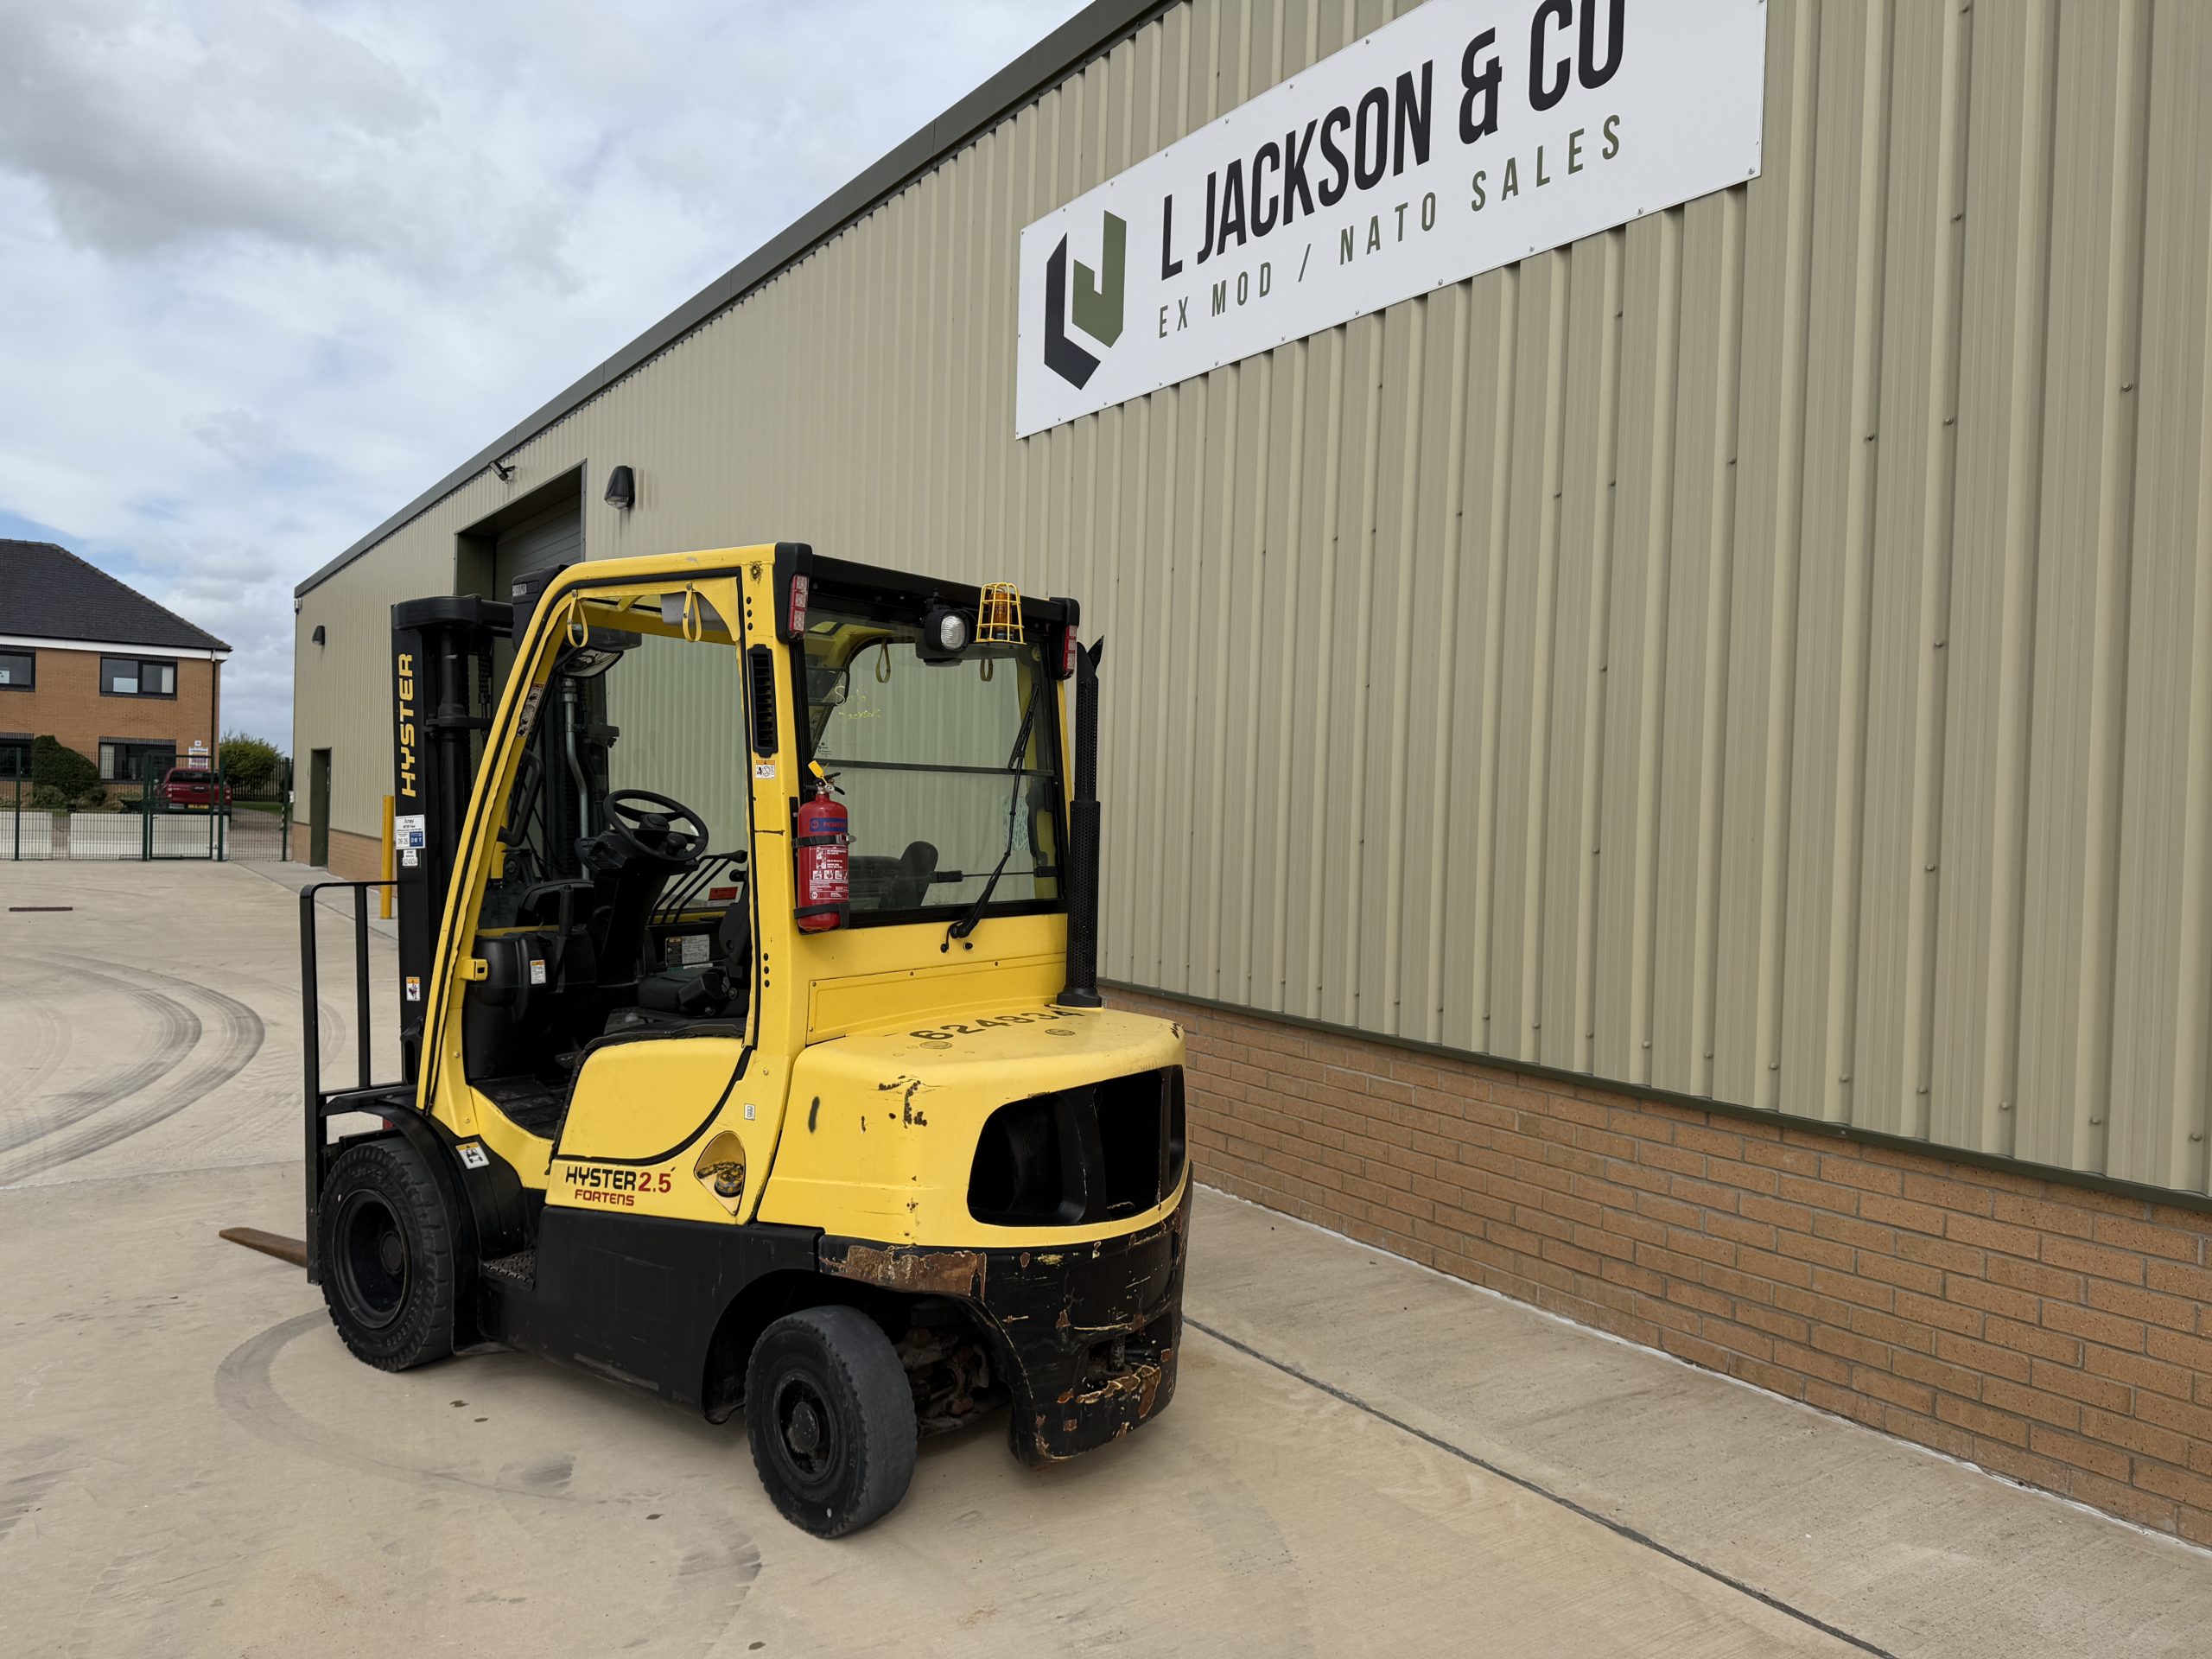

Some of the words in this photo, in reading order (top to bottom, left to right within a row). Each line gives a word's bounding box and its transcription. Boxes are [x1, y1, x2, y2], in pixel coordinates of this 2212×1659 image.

[1161, 194, 1183, 281] L
[1197, 59, 1433, 264] JACKSON
[1459, 26, 1502, 144] &
[1529, 0, 1625, 111] CO
[1159, 296, 1189, 339] EX
[1211, 261, 1272, 317] MOD
[1298, 243, 1312, 283] /
[1339, 192, 1436, 265] NATO
[1471, 114, 1620, 212] SALES
[398, 653, 416, 798] HYSTER
[909, 1009, 1086, 1040] 624934
[565, 1166, 637, 1191] HYSTER
[638, 1172, 671, 1193] 2.5
[575, 1189, 635, 1206] FORTENS
